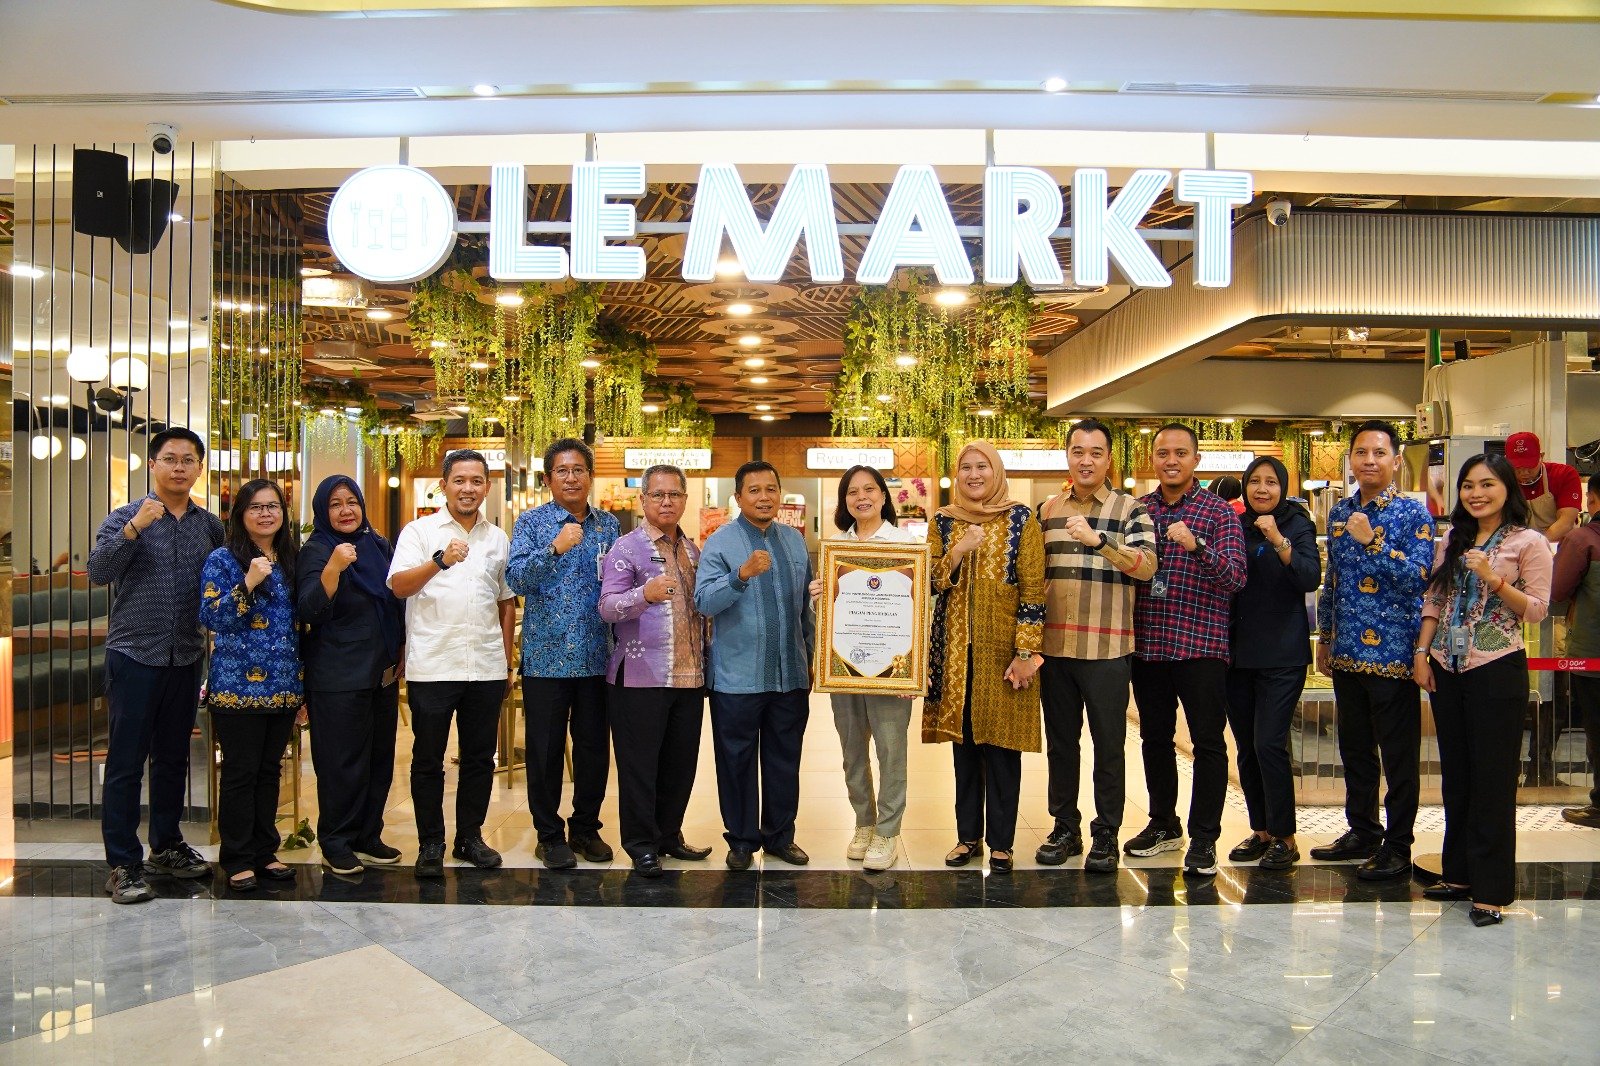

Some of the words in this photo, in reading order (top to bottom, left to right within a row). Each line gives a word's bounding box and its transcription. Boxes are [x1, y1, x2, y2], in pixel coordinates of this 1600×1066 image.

[489, 162, 648, 282] LE
[681, 162, 1253, 288] MARKT
[631, 458, 699, 467] SOMANGAT
[816, 452, 844, 465] Ryu
[858, 453, 887, 465] Don
[777, 508, 802, 520] NEW
[773, 517, 805, 528] MENU
